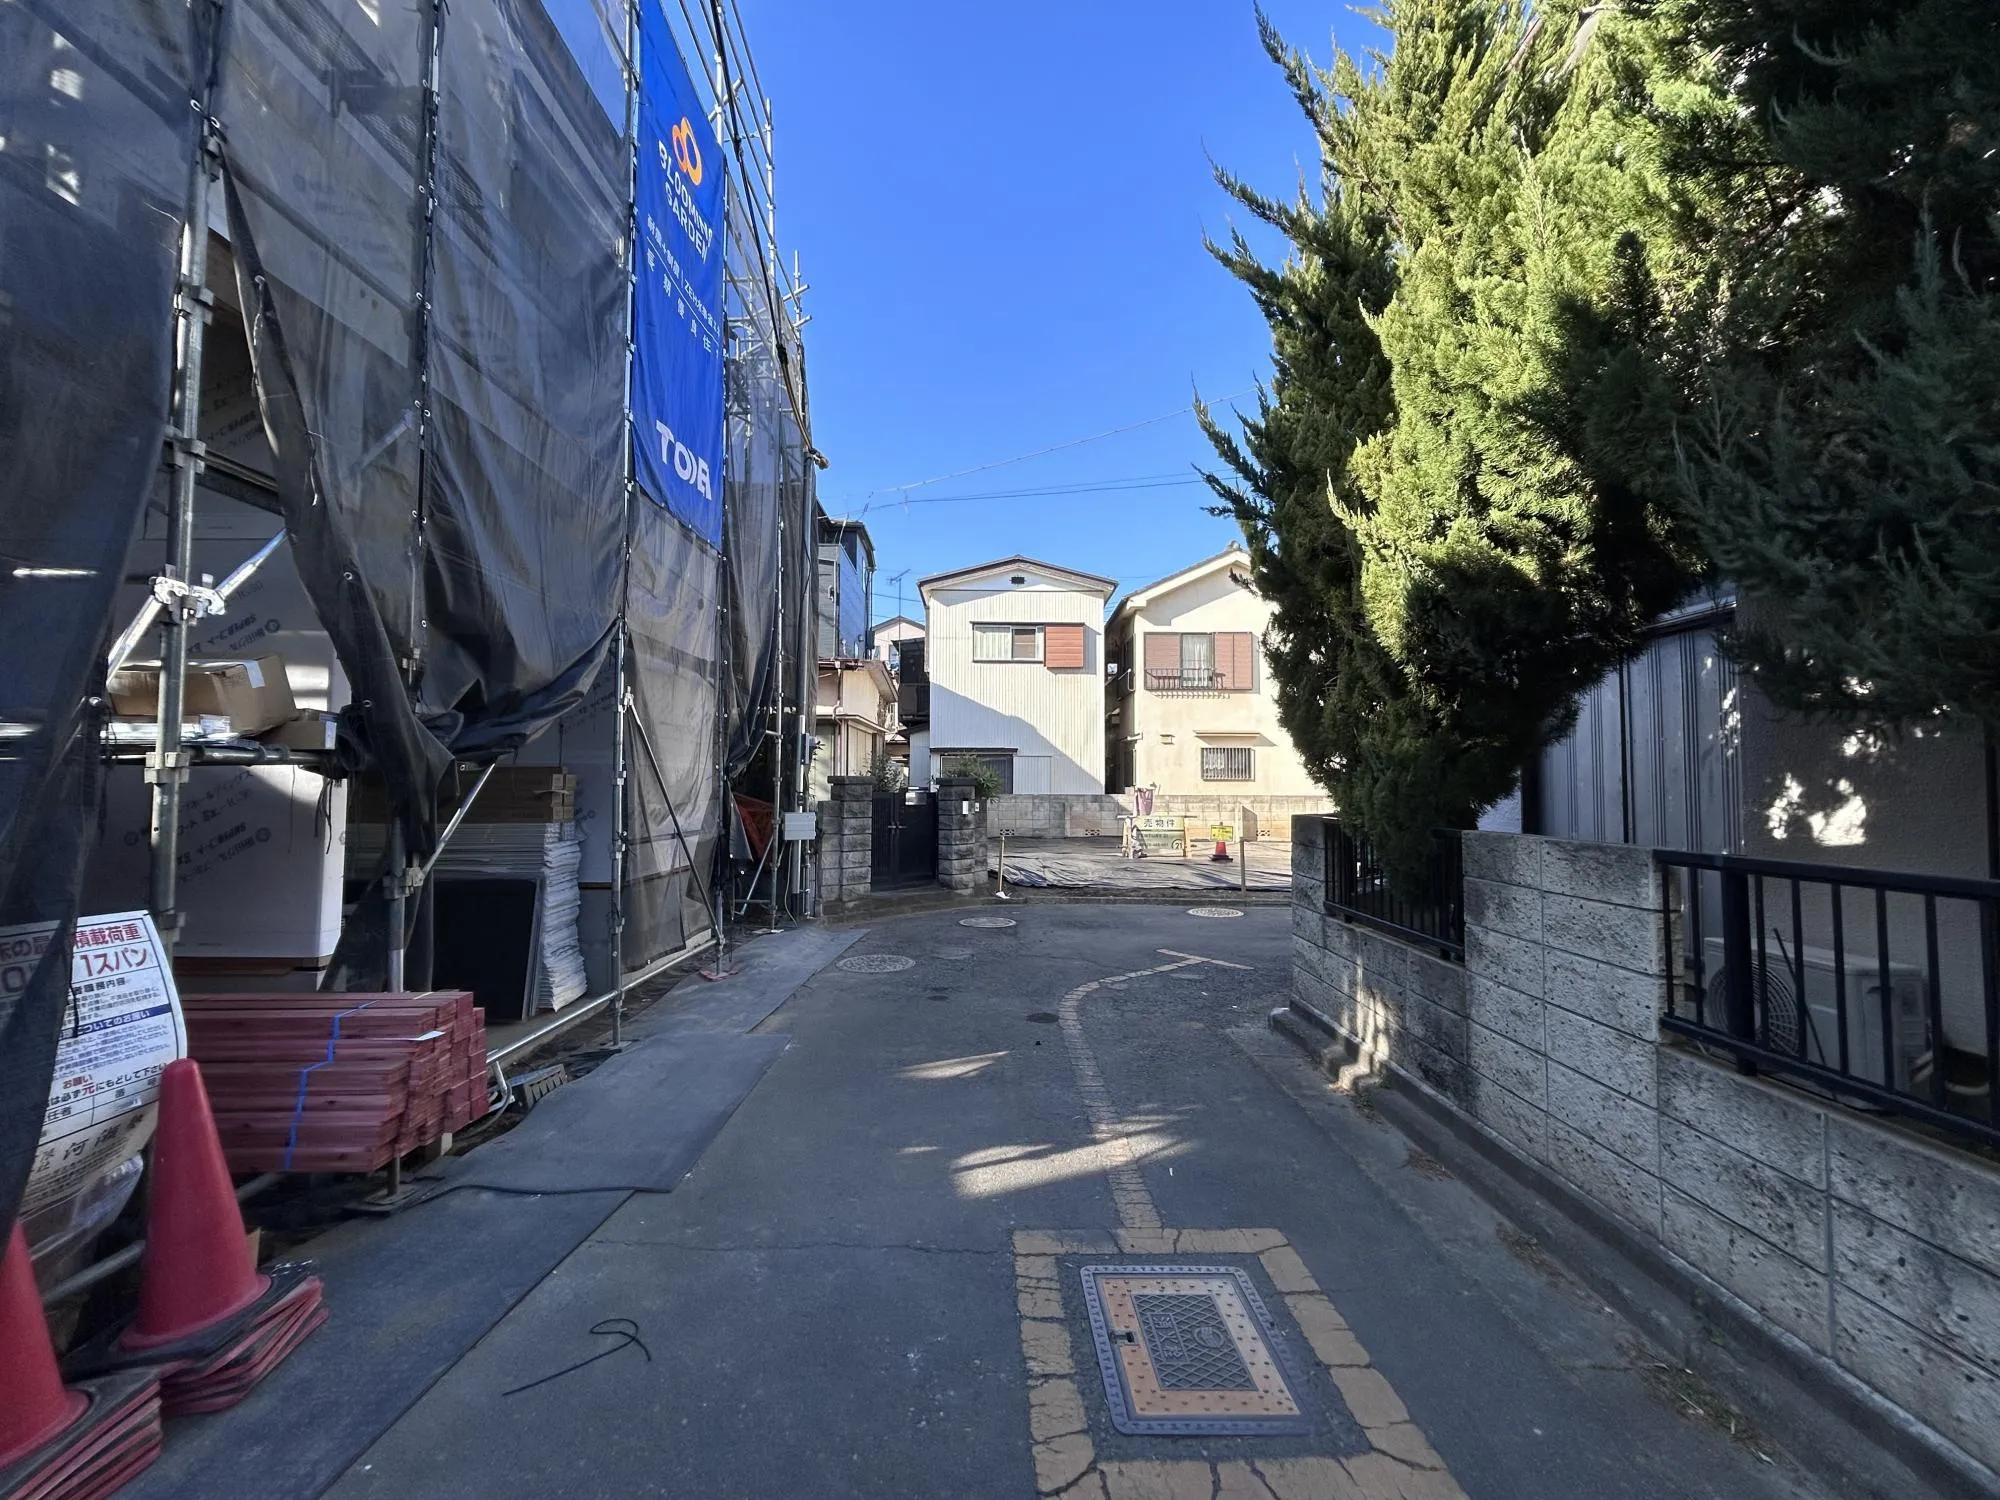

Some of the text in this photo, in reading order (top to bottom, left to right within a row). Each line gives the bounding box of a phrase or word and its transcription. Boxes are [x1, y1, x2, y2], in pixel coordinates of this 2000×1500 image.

[658, 140, 713, 248] BLOOMING
[665, 181, 708, 264] GARDEN
[1144, 818, 1175, 828] 売物件
[80, 947, 147, 977] 1スパン
[63, 1074, 92, 1089] お願い
